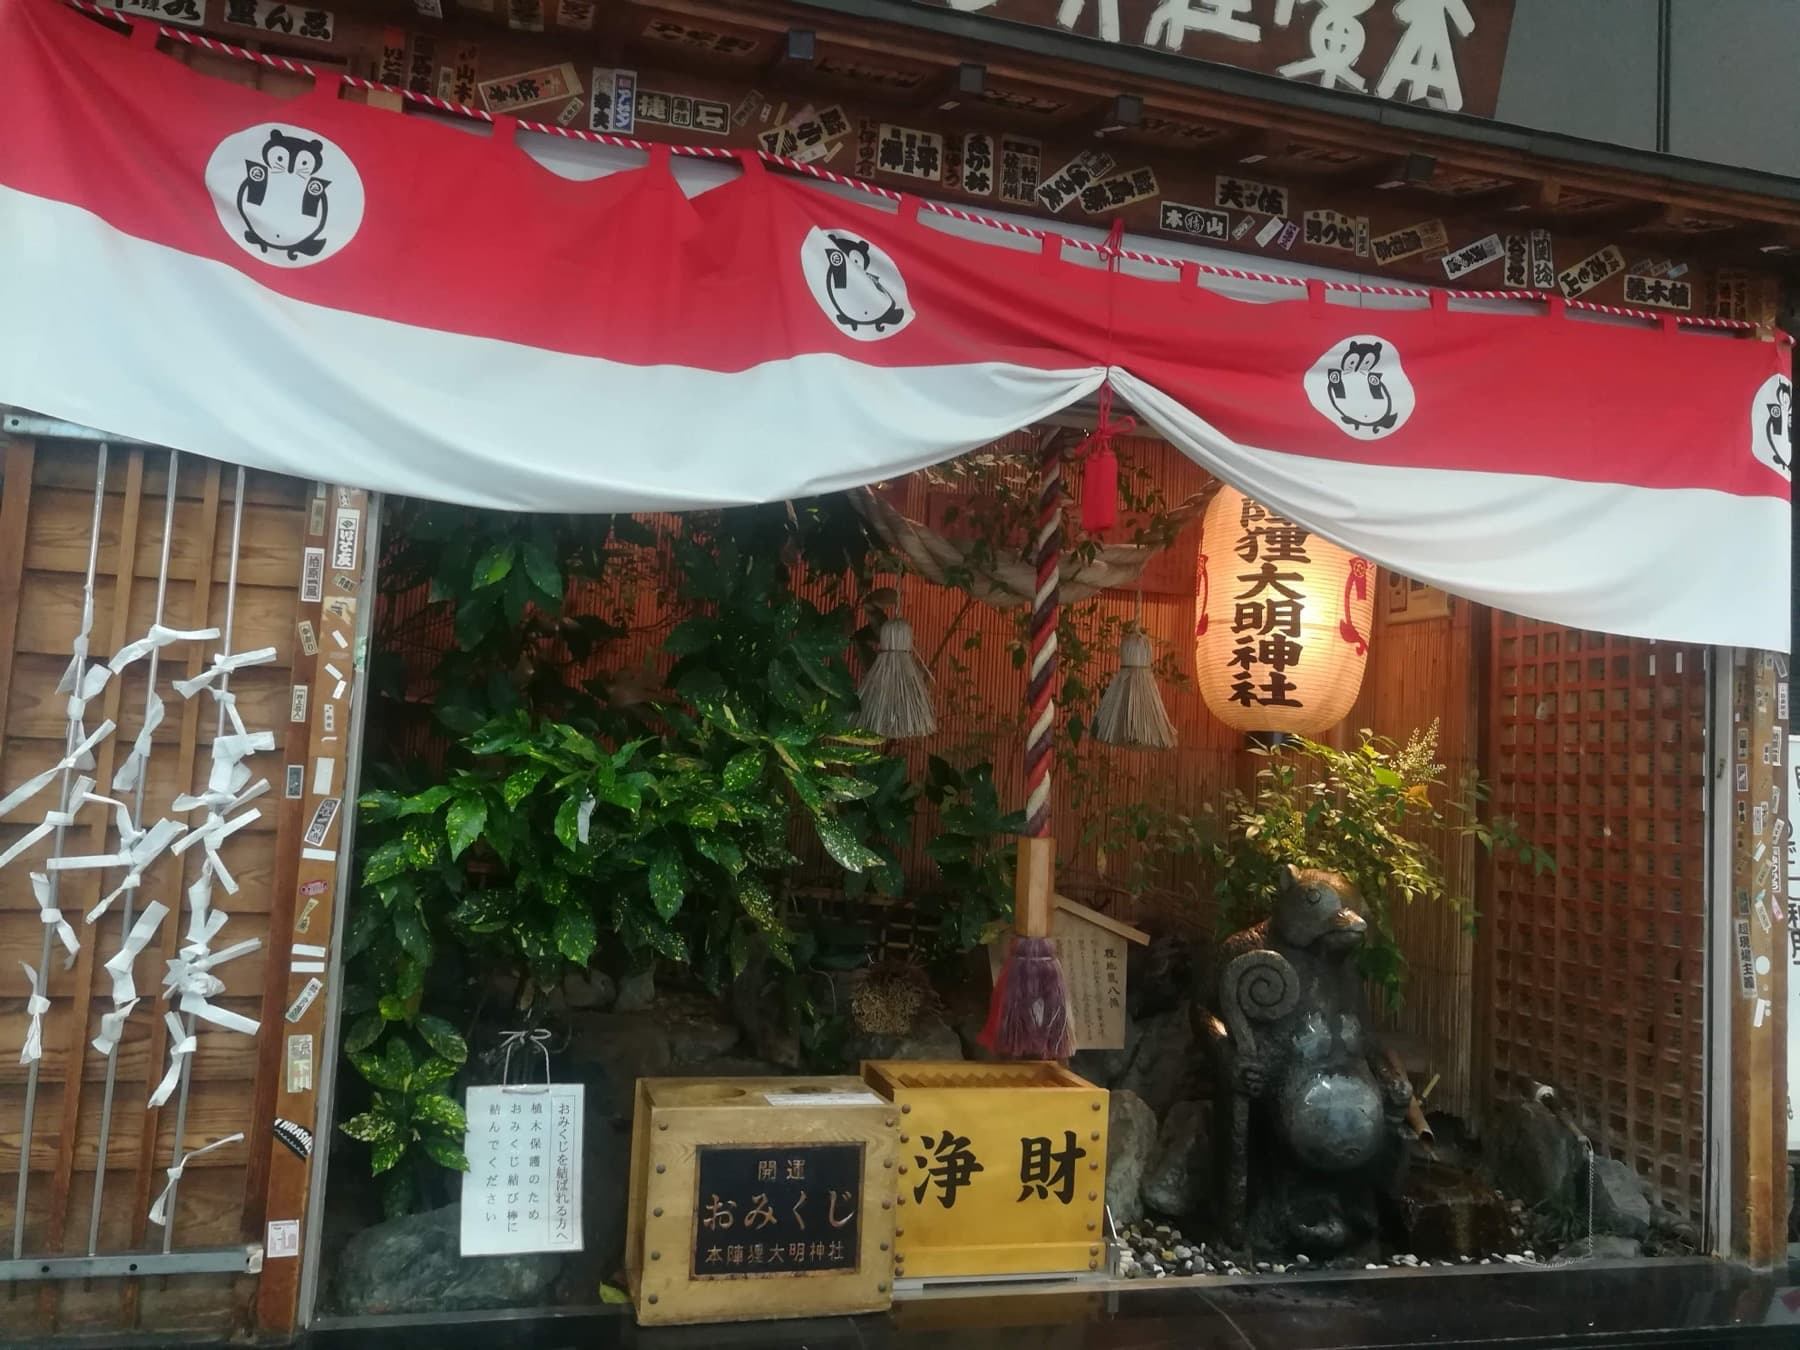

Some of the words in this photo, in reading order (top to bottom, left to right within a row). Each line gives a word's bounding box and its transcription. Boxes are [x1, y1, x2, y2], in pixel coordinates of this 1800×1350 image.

[486, 1103, 501, 1222] 結んでください
[507, 1102, 522, 1233] おみくじ結び棒に
[528, 1102, 543, 1221] 植木保護のため
[555, 1102, 570, 1240] おみくじを結ばれる方へ
[703, 1188, 856, 1233] おみくじ
[757, 1158, 806, 1182] 開運
